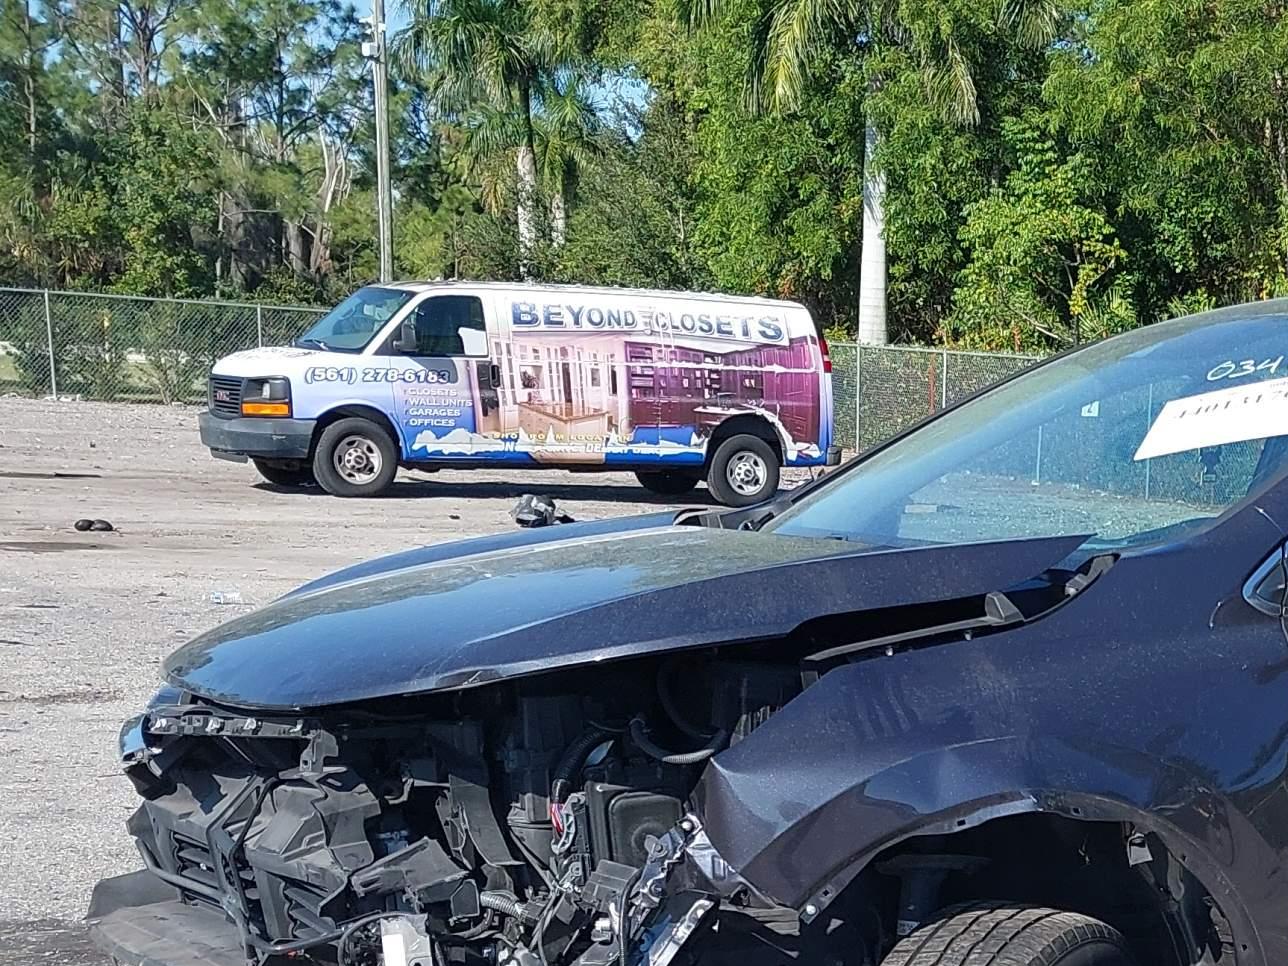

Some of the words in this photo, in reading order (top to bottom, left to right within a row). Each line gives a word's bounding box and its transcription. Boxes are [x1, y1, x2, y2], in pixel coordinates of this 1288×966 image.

[512, 302, 637, 328] BEYOND
[655, 312, 785, 342] CLOSETS
[305, 367, 357, 384] (561)
[408, 388, 458, 397] CLOSETS
[408, 399, 440, 407] WALL
[441, 399, 473, 407] UNITS
[408, 408, 461, 417] GARAGES
[409, 418, 456, 427] OFFICES
